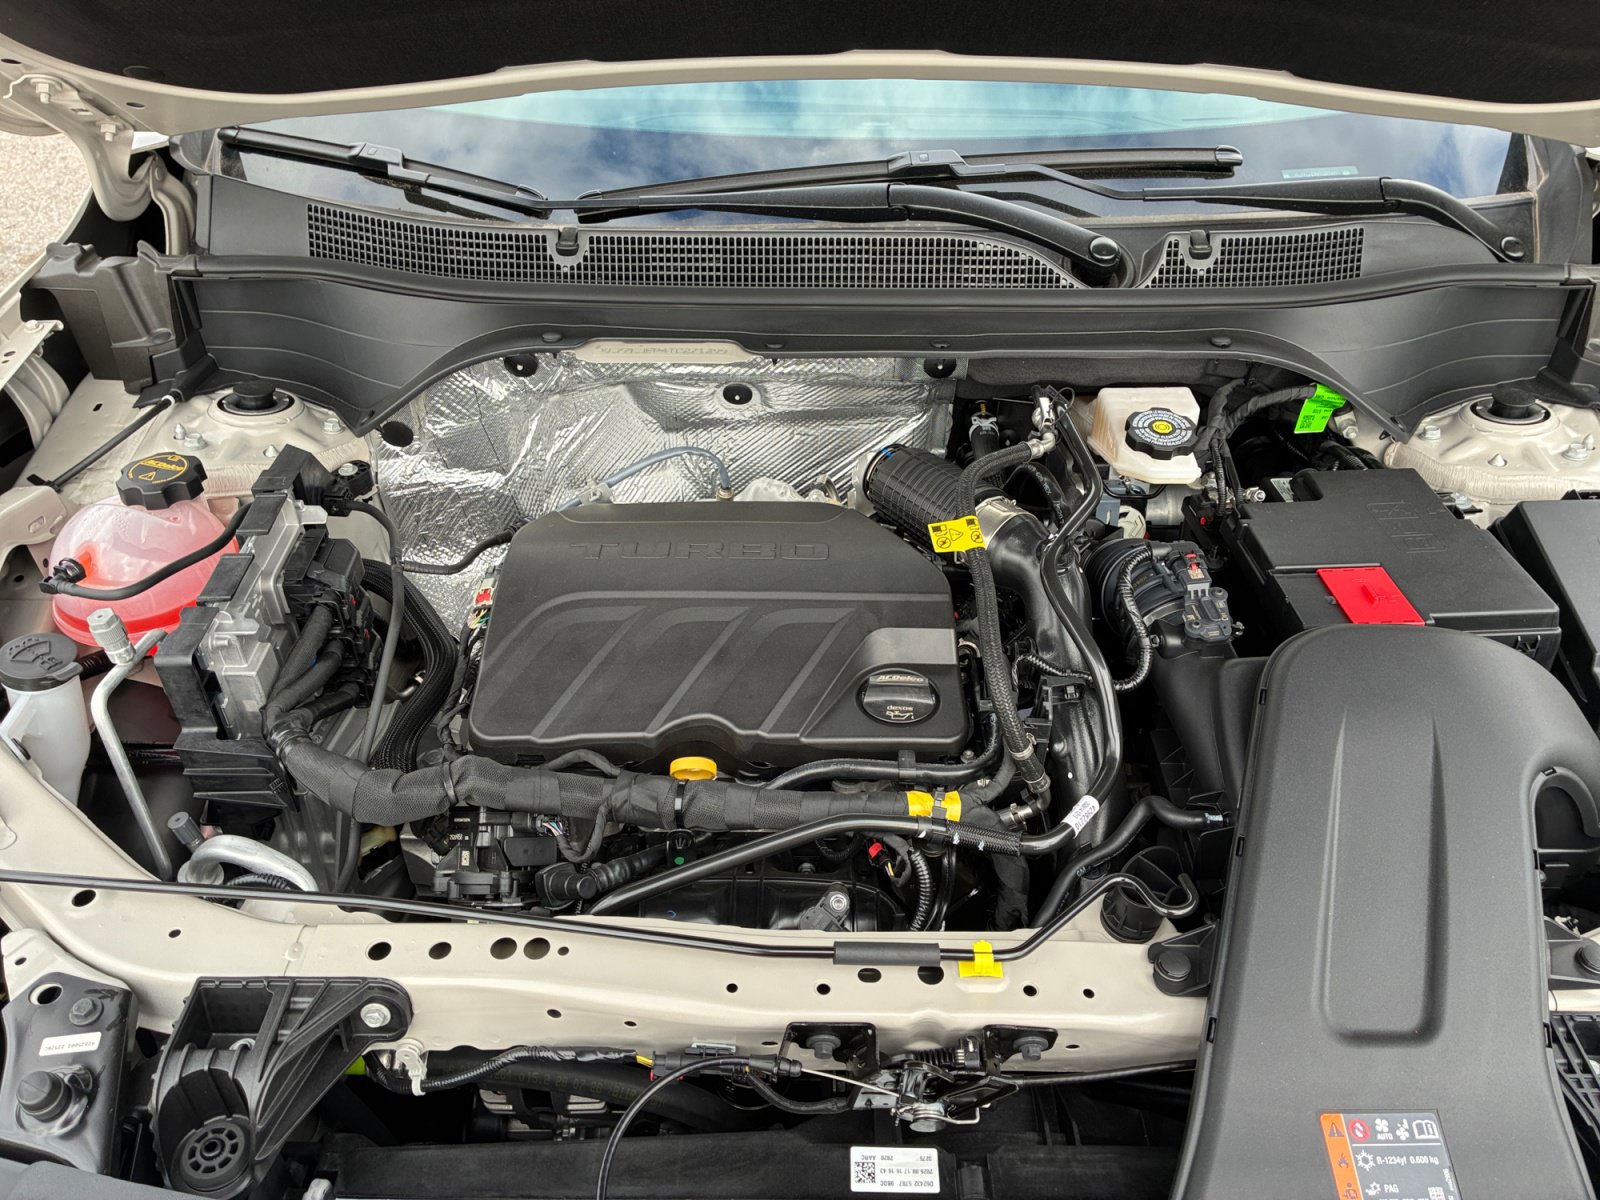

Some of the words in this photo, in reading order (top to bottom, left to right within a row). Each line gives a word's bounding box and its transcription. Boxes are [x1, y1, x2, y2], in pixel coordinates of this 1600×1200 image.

[568, 542, 830, 561] TURBO
[878, 674, 924, 682] ACDelco
[1376, 1133, 1394, 1141] AUTO
[1376, 1156, 1407, 1166] R-1234yf
[1383, 1184, 1400, 1194] PAG
